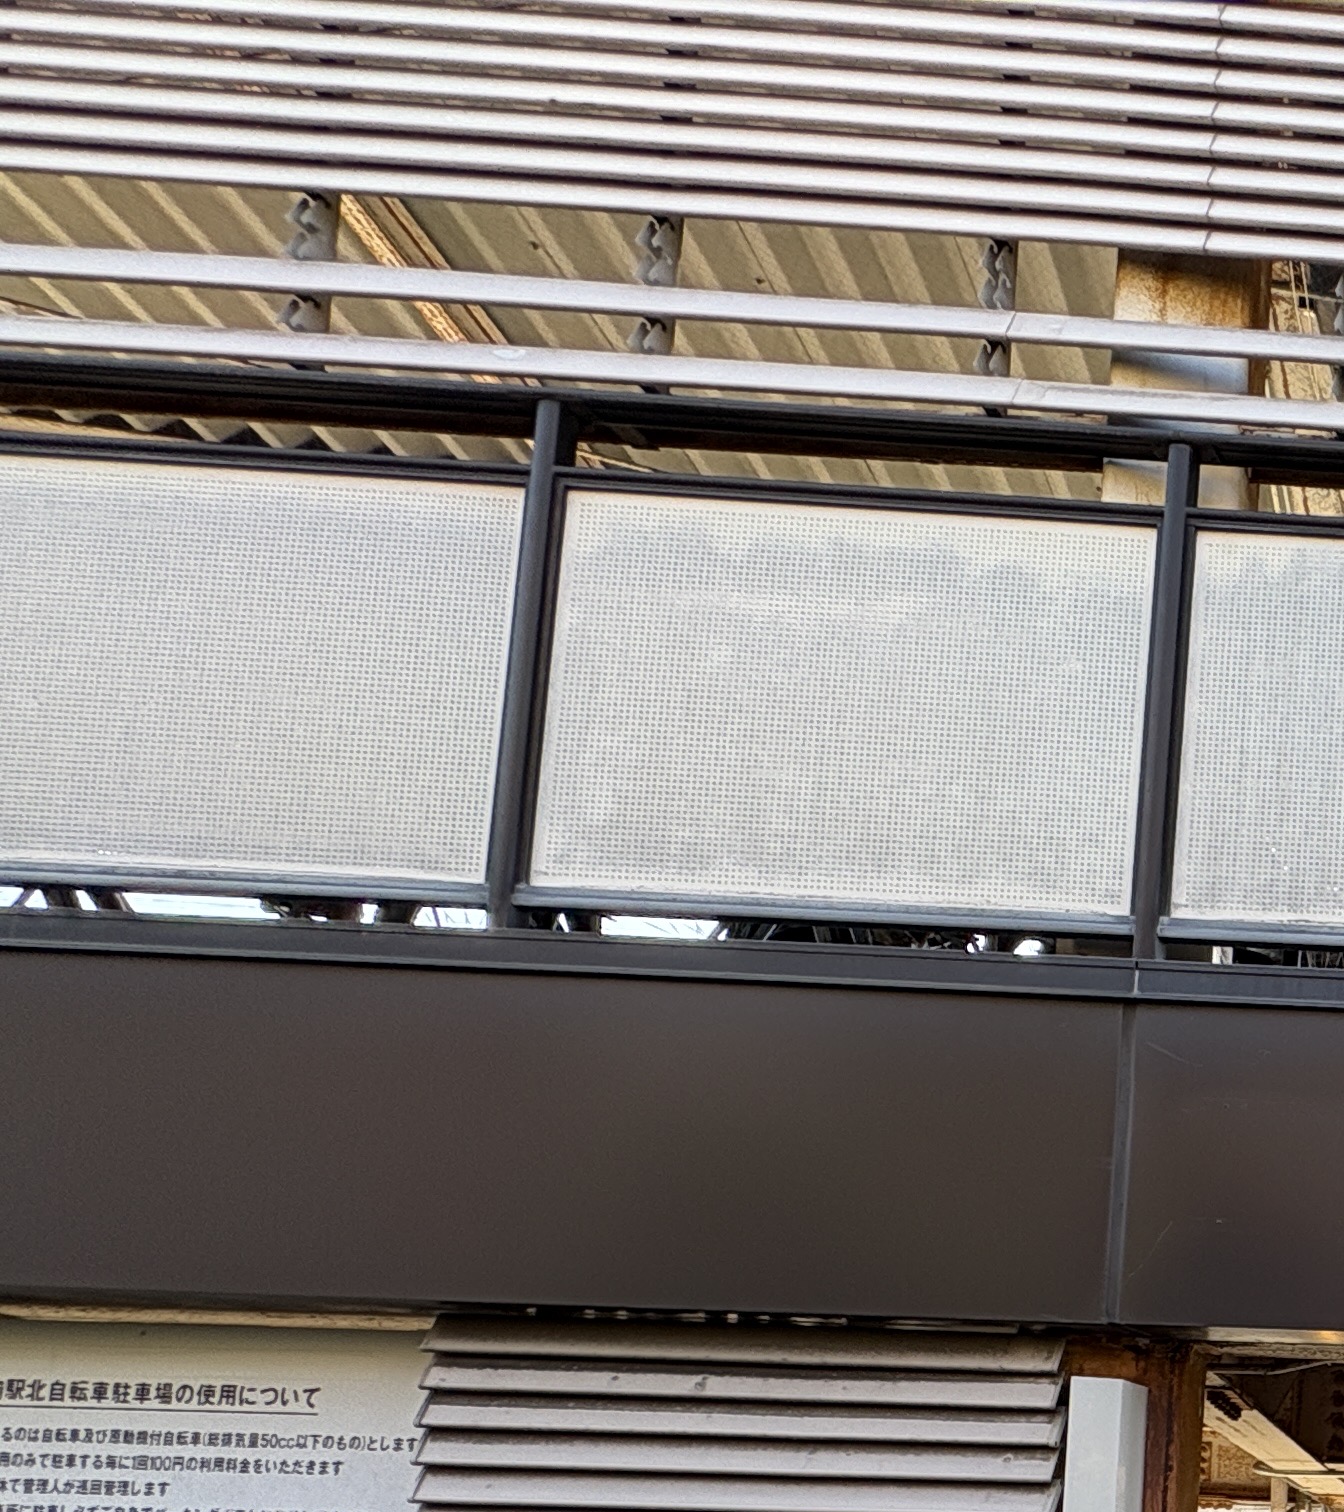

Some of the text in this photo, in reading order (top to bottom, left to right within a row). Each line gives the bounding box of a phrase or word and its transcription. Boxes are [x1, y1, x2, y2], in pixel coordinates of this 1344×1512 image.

[0, 1378, 321, 1409] 駅北自転車駐車場の使用について
